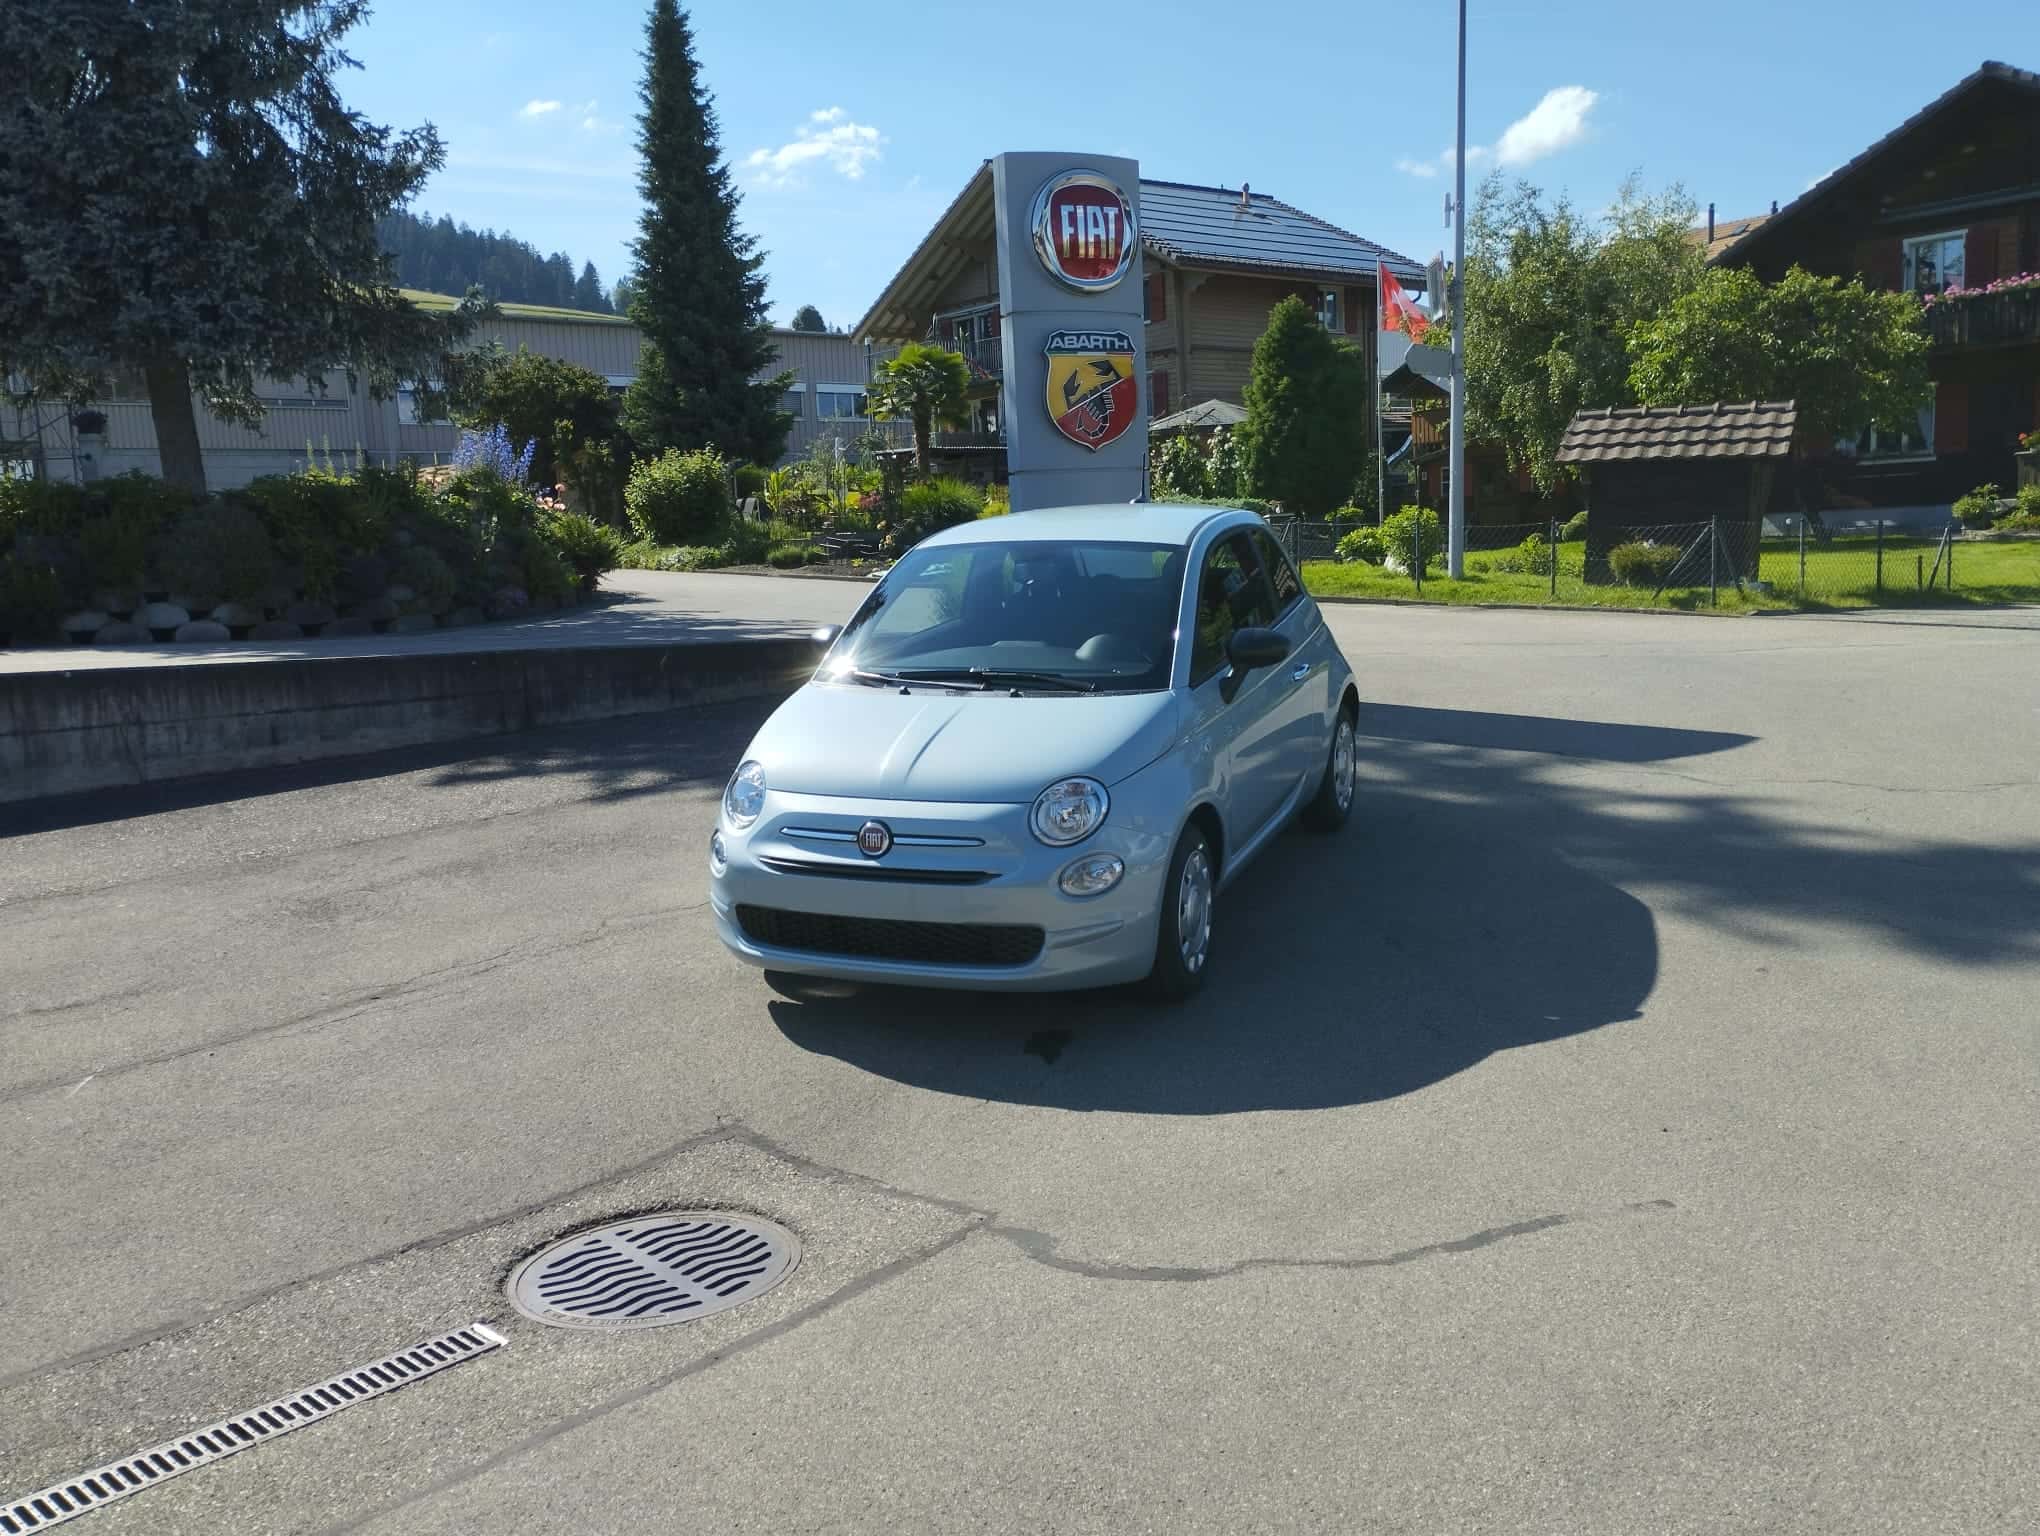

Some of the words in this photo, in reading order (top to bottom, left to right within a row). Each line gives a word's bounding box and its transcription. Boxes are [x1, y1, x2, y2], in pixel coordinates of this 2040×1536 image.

[1060, 204, 1119, 259] FIAT
[1050, 334, 1129, 350] ABARTH
[865, 832, 882, 848] FIAT
